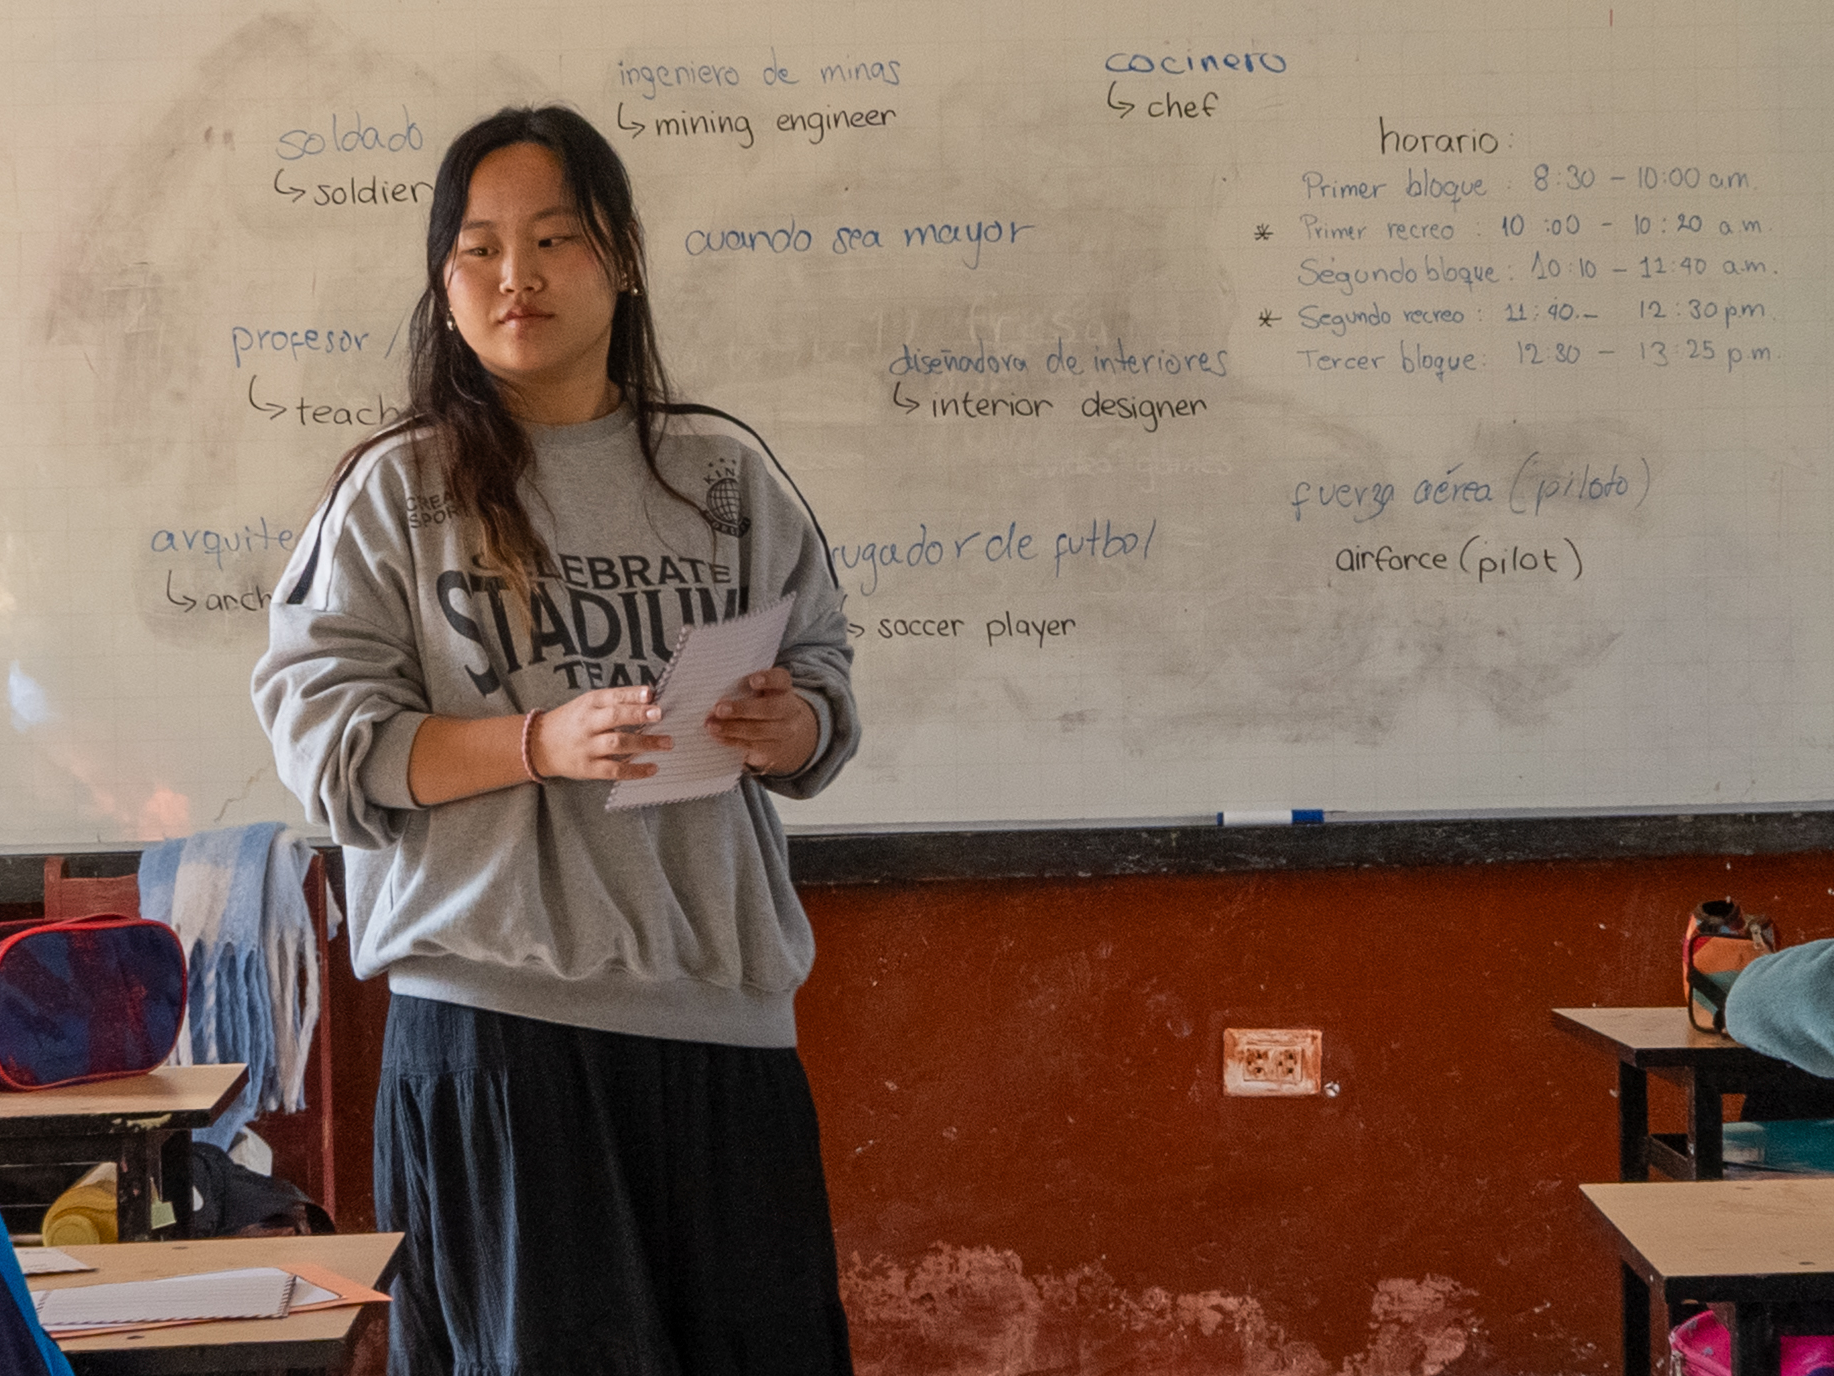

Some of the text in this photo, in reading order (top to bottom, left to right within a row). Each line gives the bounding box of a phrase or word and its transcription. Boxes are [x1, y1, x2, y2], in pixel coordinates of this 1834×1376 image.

[618, 46, 902, 100] ingeniero de minas
[1105, 49, 1287, 74] cocinero
[1147, 91, 1219, 118] chef
[276, 104, 424, 161] soldado
[655, 104, 897, 149] mining engineer
[313, 175, 434, 207] soldier
[1302, 171, 1387, 199] Primer
[685, 219, 1035, 270] cuando sea mayor
[1299, 214, 1366, 240] Primer
[1298, 257, 1418, 296] Segundo
[1298, 302, 1391, 337] Segundo
[231, 326, 369, 369] profesor
[889, 337, 1229, 377] diseñadora de interiores
[1297, 350, 1385, 371] Tercer
[932, 391, 1208, 433] interior designer
[1292, 481, 1396, 524] fuerza
[1413, 462, 1494, 505] aérea
[985, 521, 1039, 562] de
[1054, 518, 1157, 578] futbol
[1335, 543, 1449, 573] airforce
[878, 610, 1076, 650] soccer player
